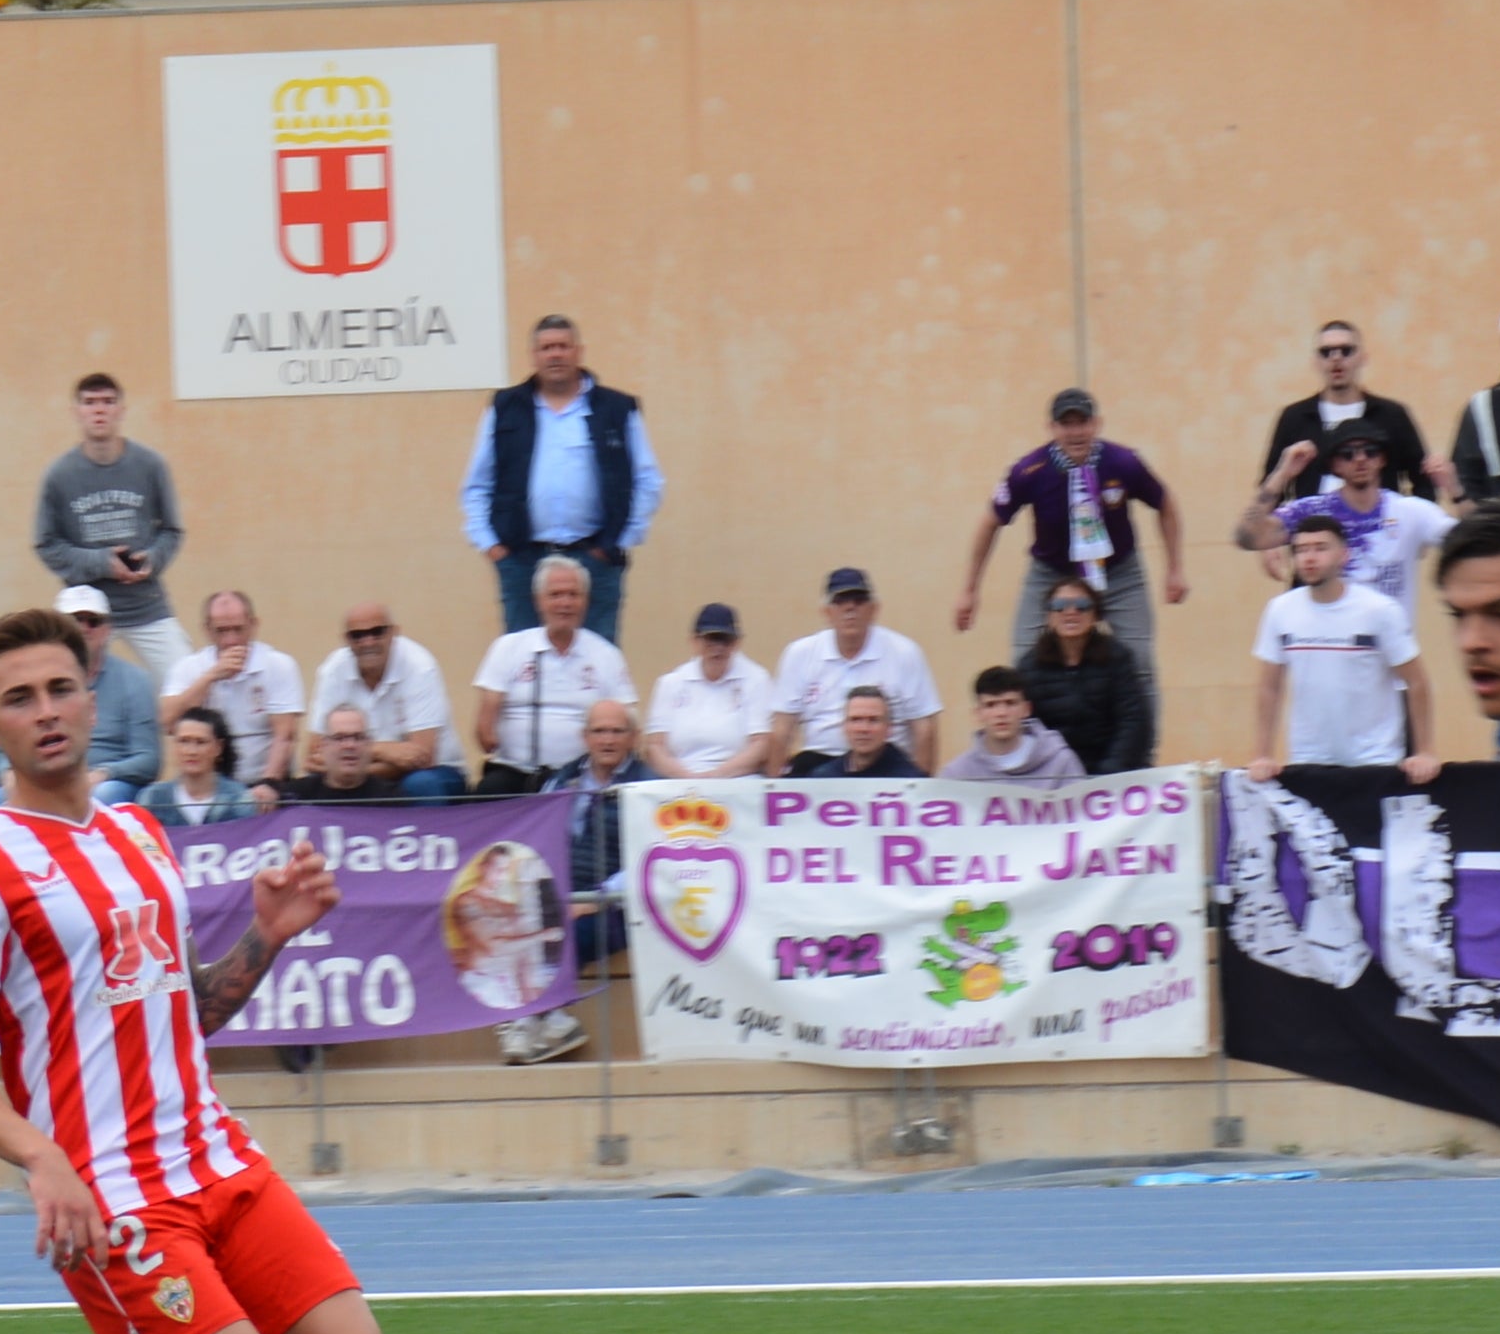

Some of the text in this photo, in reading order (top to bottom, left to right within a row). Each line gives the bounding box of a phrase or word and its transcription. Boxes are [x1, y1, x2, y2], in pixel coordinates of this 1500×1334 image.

[222, 296, 457, 354] ALMERÍA
[279, 355, 402, 385] CIUDAD
[763, 780, 1190, 828] Peña AMIGOS
[320, 825, 460, 873] Jaén
[765, 847, 857, 884] DEL
[775, 931, 886, 981] 1922
[1050, 921, 1180, 973] 2019
[1030, 1008, 1085, 1038] una
[1099, 967, 1197, 1042] pasión
[109, 1214, 164, 1277] 2
